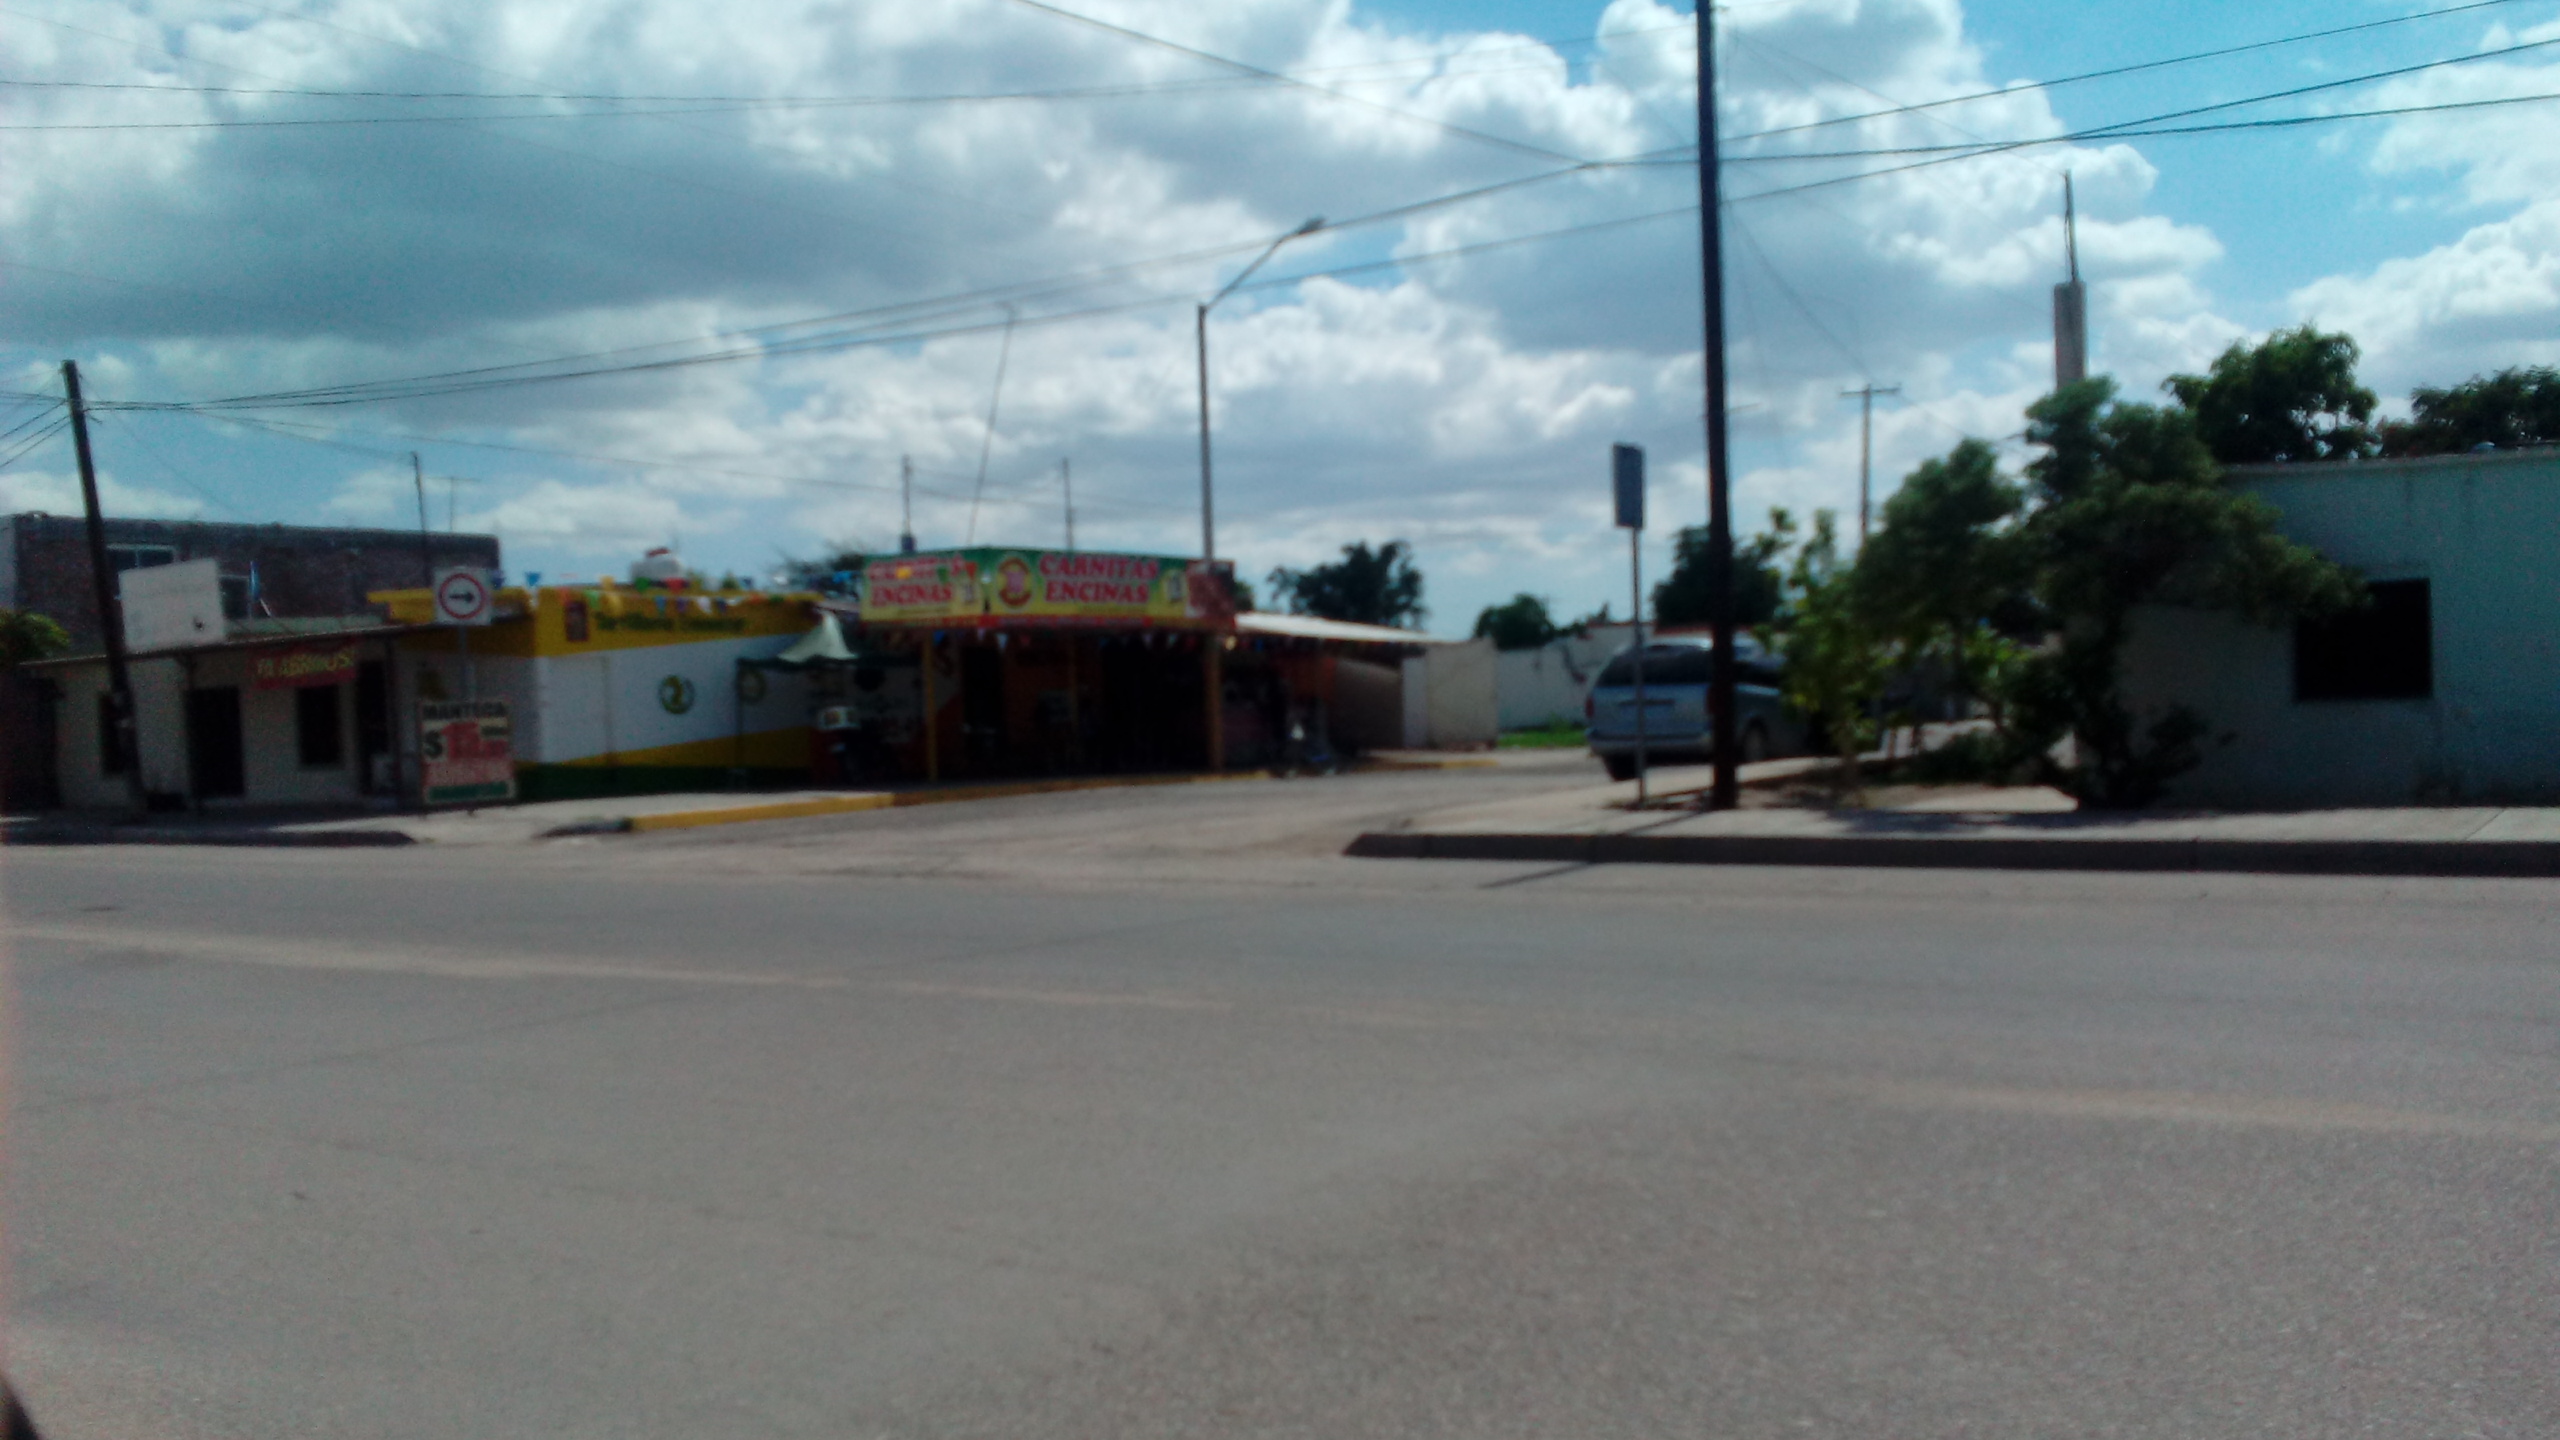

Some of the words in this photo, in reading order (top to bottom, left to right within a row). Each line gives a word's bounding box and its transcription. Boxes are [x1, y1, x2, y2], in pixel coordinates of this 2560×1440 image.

[1039, 554, 1160, 580] CARNITAS
[871, 583, 953, 607] ENCINAS
[1045, 580, 1150, 604] ENCINAS
